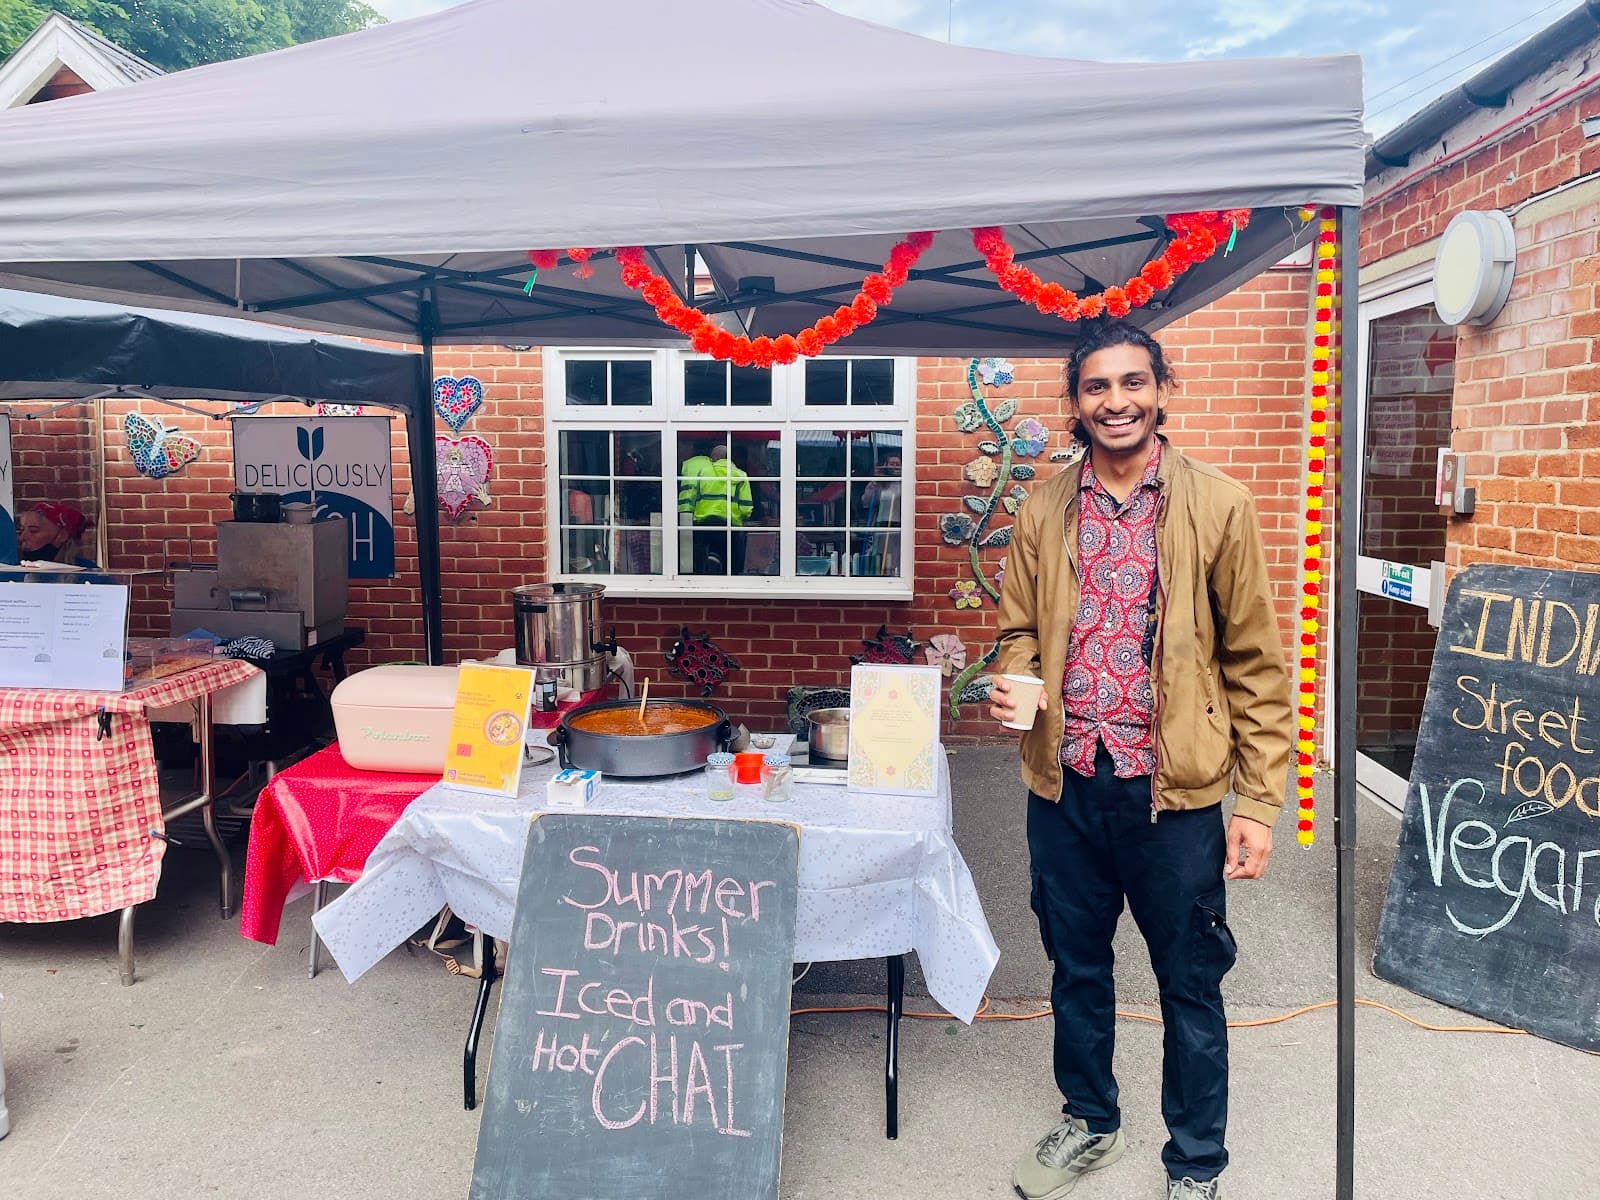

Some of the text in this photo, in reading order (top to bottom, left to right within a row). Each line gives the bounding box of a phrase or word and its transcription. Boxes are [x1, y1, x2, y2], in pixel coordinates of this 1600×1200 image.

[245, 463, 386, 490] DELICIOUSLY
[1452, 675, 1595, 754] Street
[583, 911, 731, 971] Drinks!
[536, 967, 733, 1030] Iced and
[531, 1027, 752, 1137] Hot CHAI
